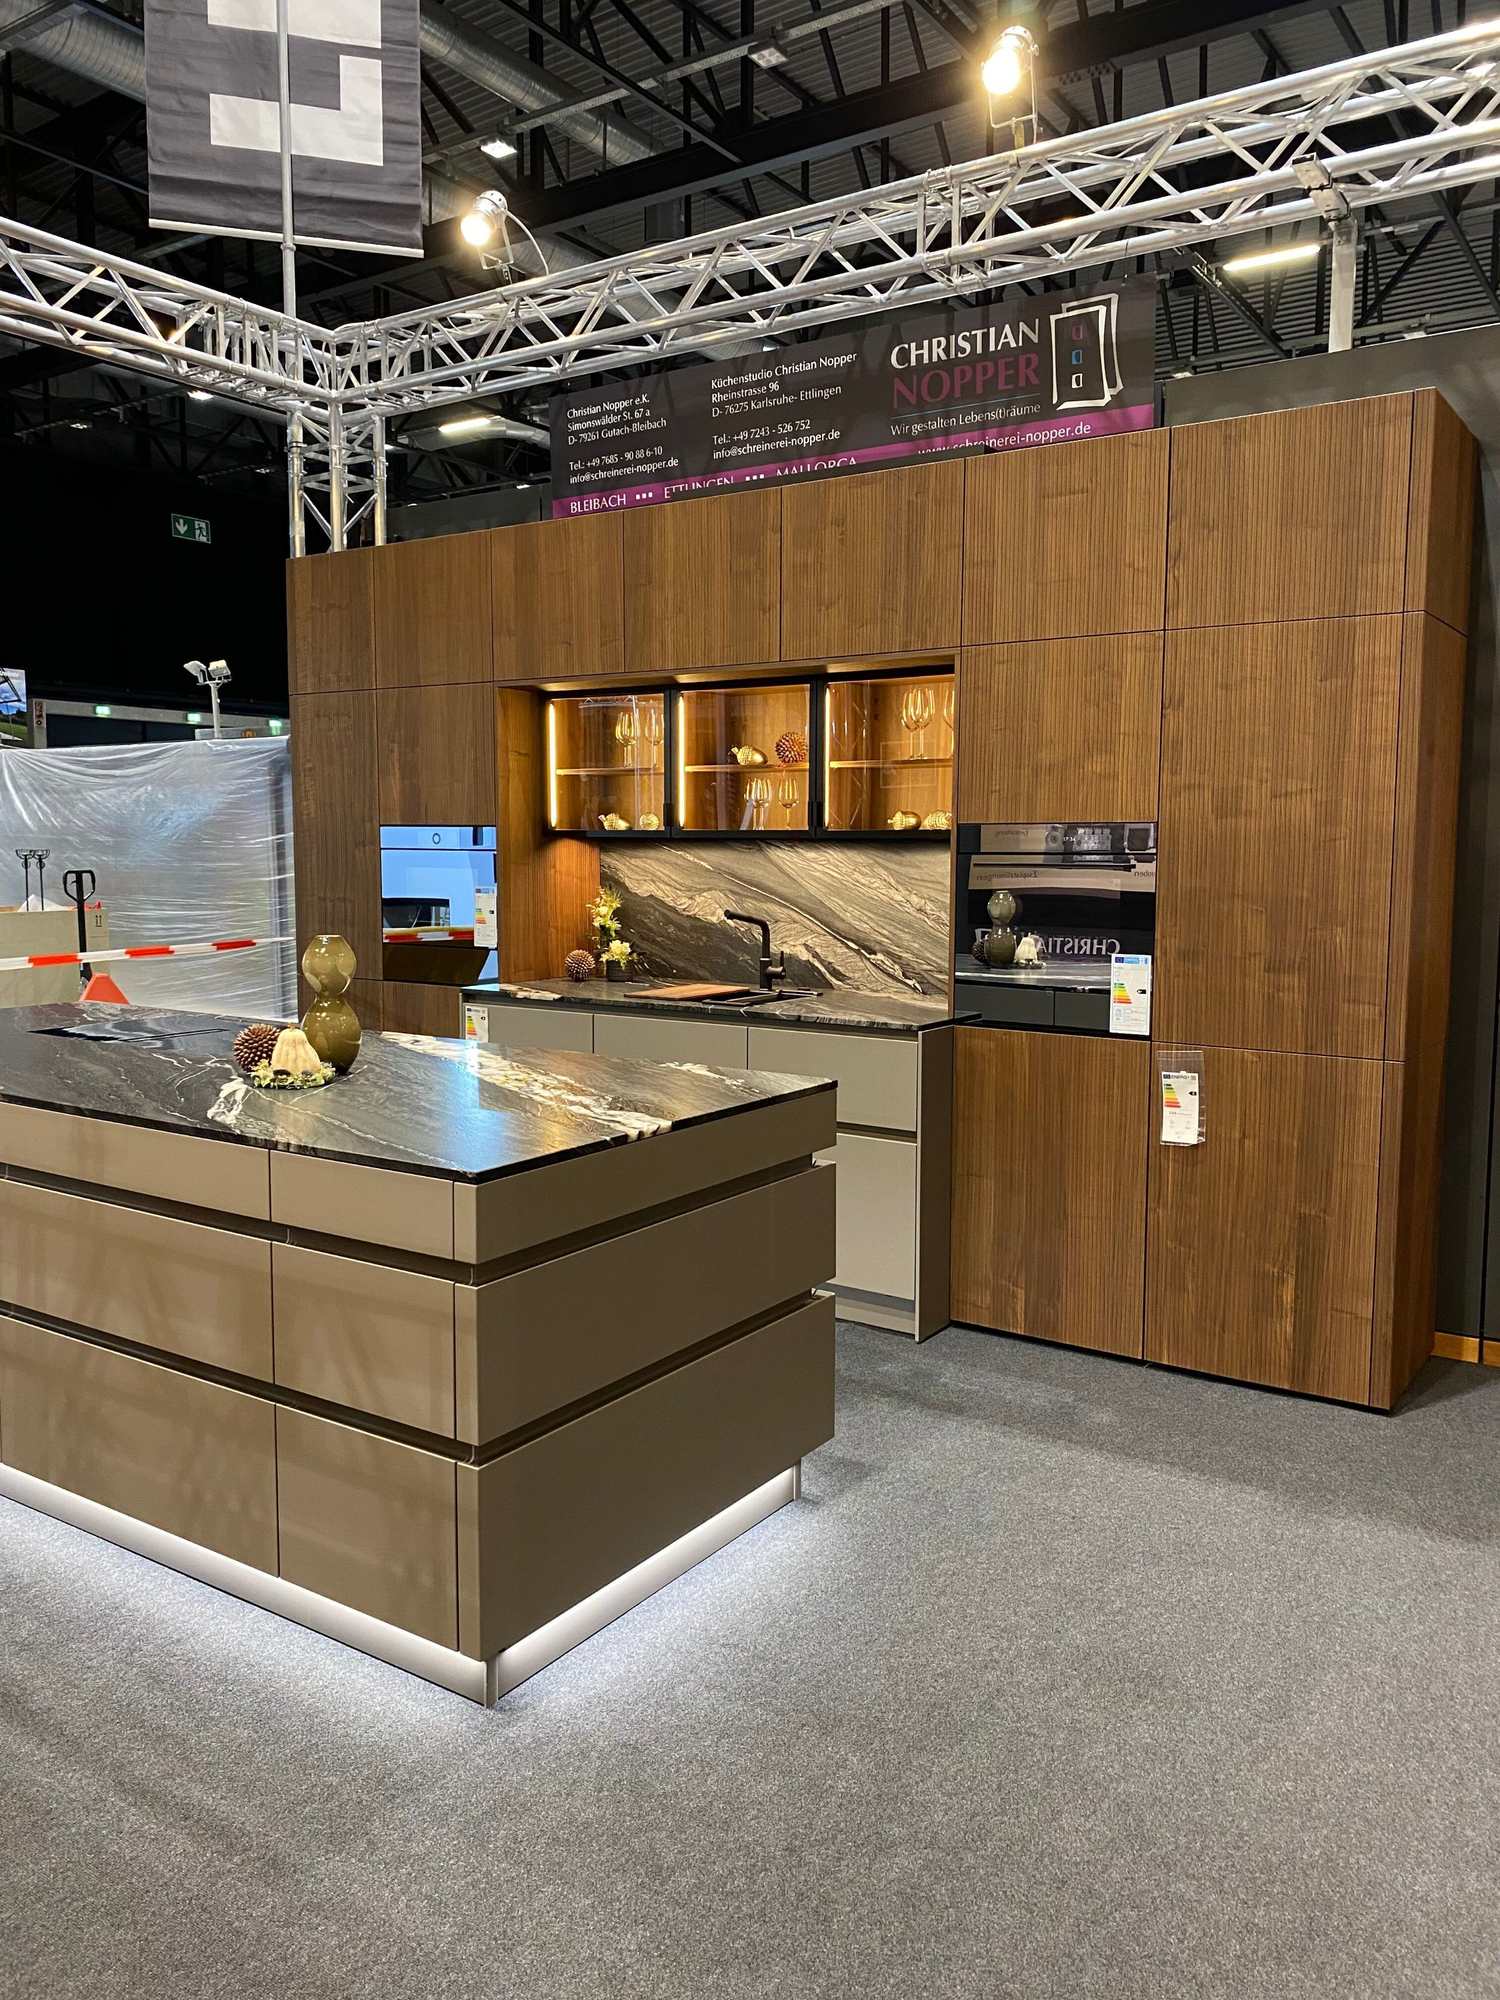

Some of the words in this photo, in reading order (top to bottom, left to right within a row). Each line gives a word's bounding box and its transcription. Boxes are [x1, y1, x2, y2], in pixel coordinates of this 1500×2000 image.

[890, 318, 1040, 369] CHRISTIAN
[711, 369, 773, 389] Küchenstudio
[775, 360, 817, 376] Christian
[819, 353, 858, 368] Nopper
[893, 352, 1041, 409] NOPPER
[711, 385, 767, 403] Rheinstrasse
[768, 381, 780, 392] 96
[724, 401, 749, 415] 76275
[800, 385, 842, 401] Ettlingen
[567, 405, 602, 419] Christian
[602, 399, 634, 412] Nopper
[567, 413, 621, 432] Simonswälder
[634, 408, 644, 418] 67
[890, 422, 910, 436] Wir
[911, 415, 957, 437] gestalten
[959, 403, 1041, 425] Lebens(t)räume
[579, 431, 600, 443] 79261
[601, 417, 667, 439] Gutach-Bleibach
[712, 433, 731, 446] Tel.:
[732, 430, 749, 441] +49
[750, 426, 770, 439] 7243
[777, 423, 793, 434] 526
[794, 419, 811, 431] 752
[586, 457, 600, 468] +49
[601, 454, 619, 466] 7685
[624, 451, 634, 461] 90
[635, 449, 645, 459] 88
[646, 445, 663, 457] 6-10
[713, 428, 841, 460] info@schreinerei-nopper.de
[569, 457, 679, 484] info@schreinerei-nopper.de
[570, 493, 627, 513] BLEIBACH
